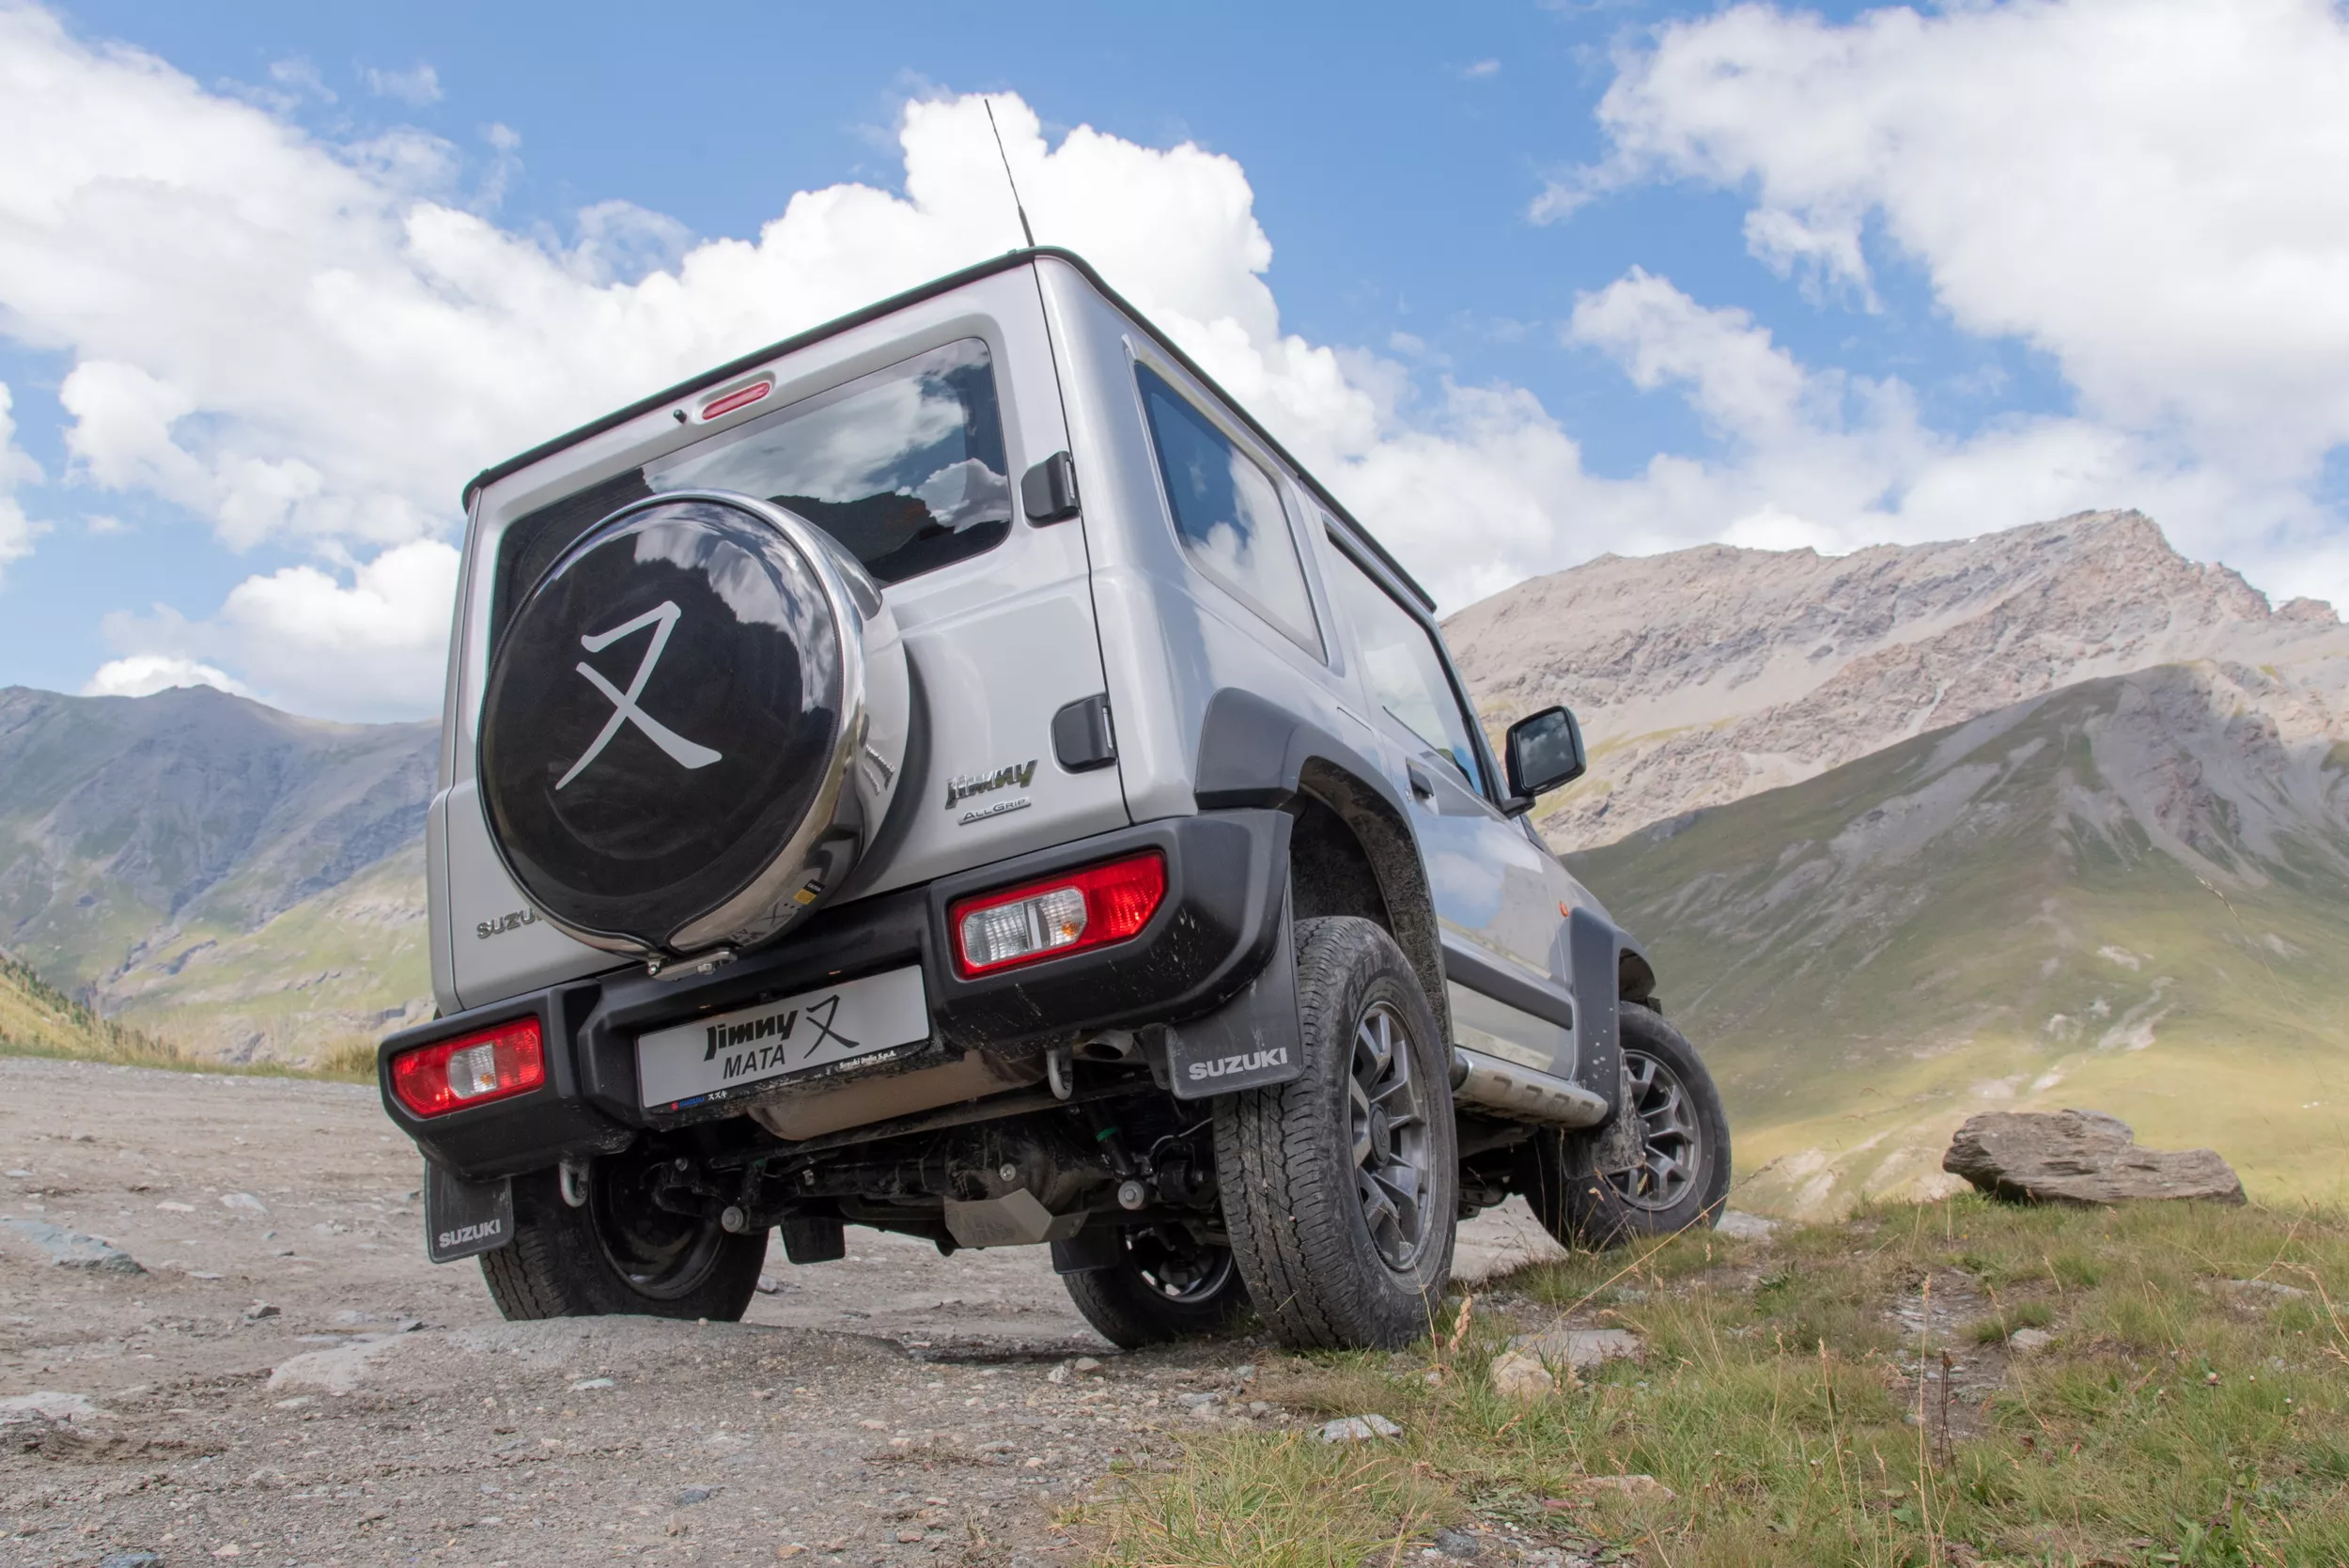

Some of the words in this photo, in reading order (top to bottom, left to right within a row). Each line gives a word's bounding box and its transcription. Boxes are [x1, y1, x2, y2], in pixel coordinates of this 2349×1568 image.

[476, 907, 543, 939] SUZU
[704, 1010, 798, 1062] Jimny
[723, 1044, 786, 1079] MATA
[1189, 1048, 1287, 1080] SUZUKI
[439, 1219, 501, 1248] SUZUKI
